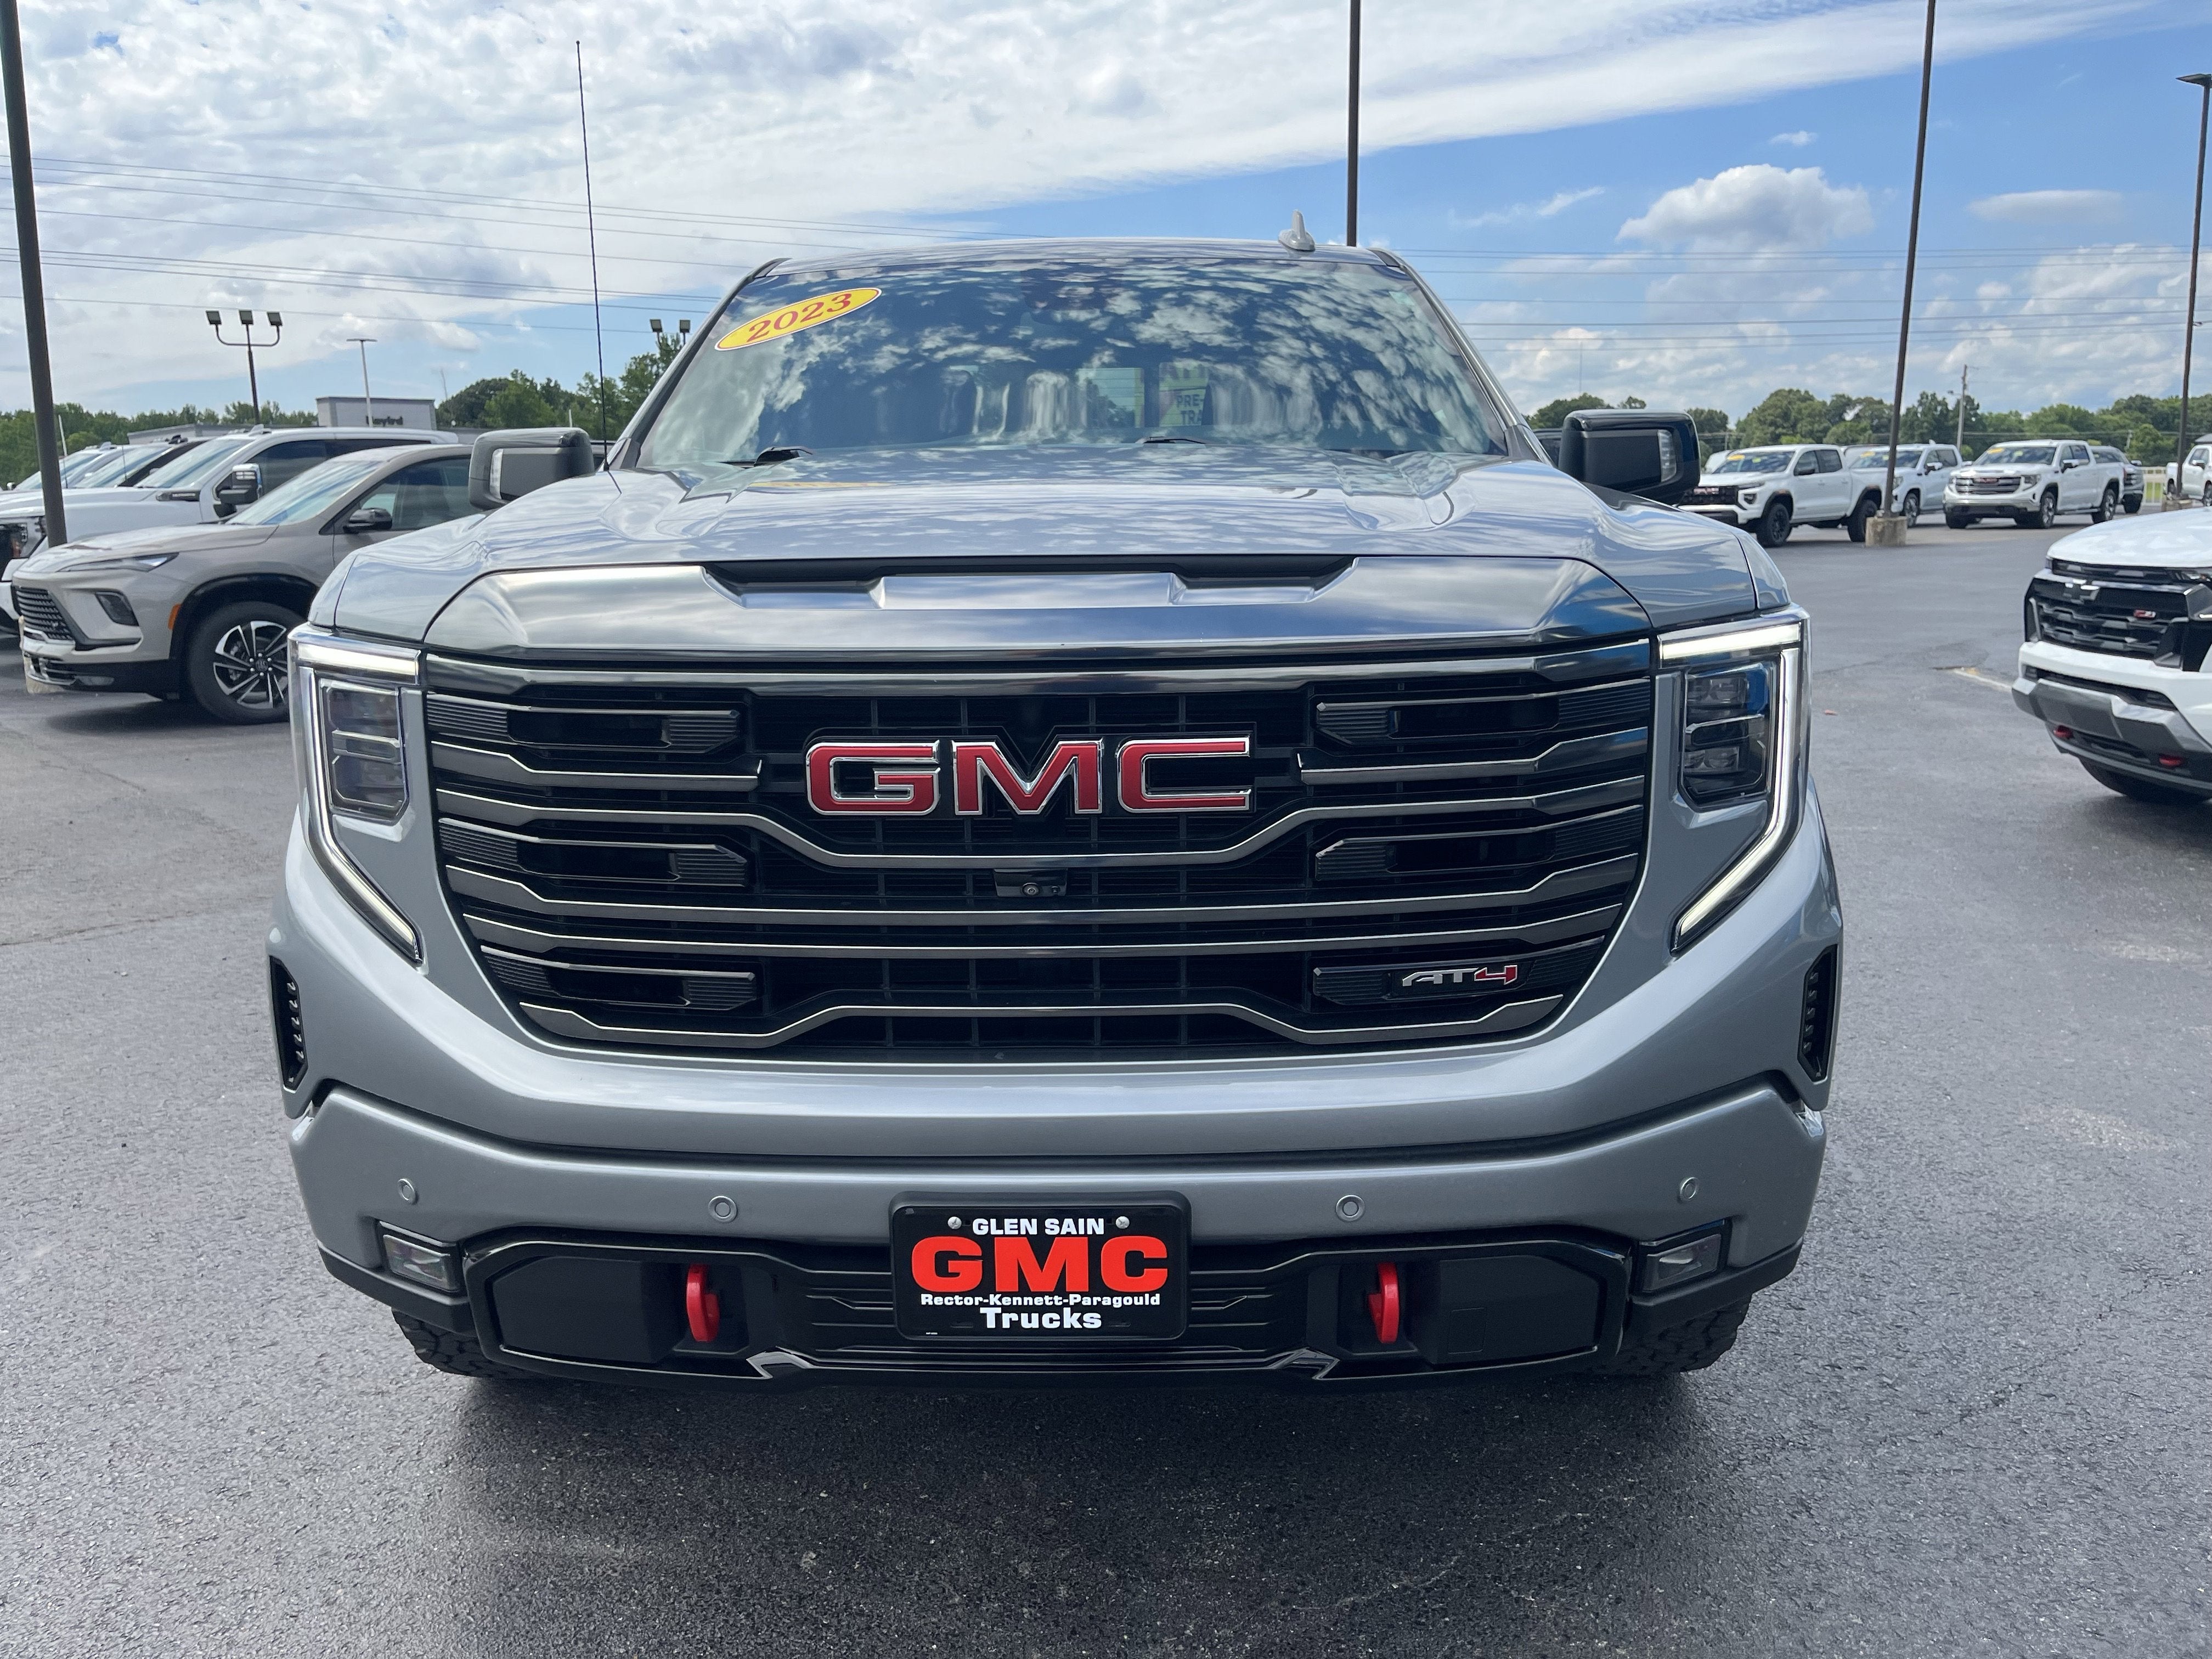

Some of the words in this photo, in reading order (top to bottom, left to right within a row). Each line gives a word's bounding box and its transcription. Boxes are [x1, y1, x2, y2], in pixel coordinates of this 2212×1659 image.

[746, 293, 853, 343] 2023
[806, 737, 1252, 816] GMC
[1402, 964, 1517, 987] AT4
[972, 1218, 1038, 1235] GLEN
[1045, 1218, 1104, 1235] SAIN
[911, 1235, 1168, 1293] GMC
[921, 1293, 1160, 1308] Rector-Kennett-Paragould
[980, 1307, 1102, 1329] Trucks
